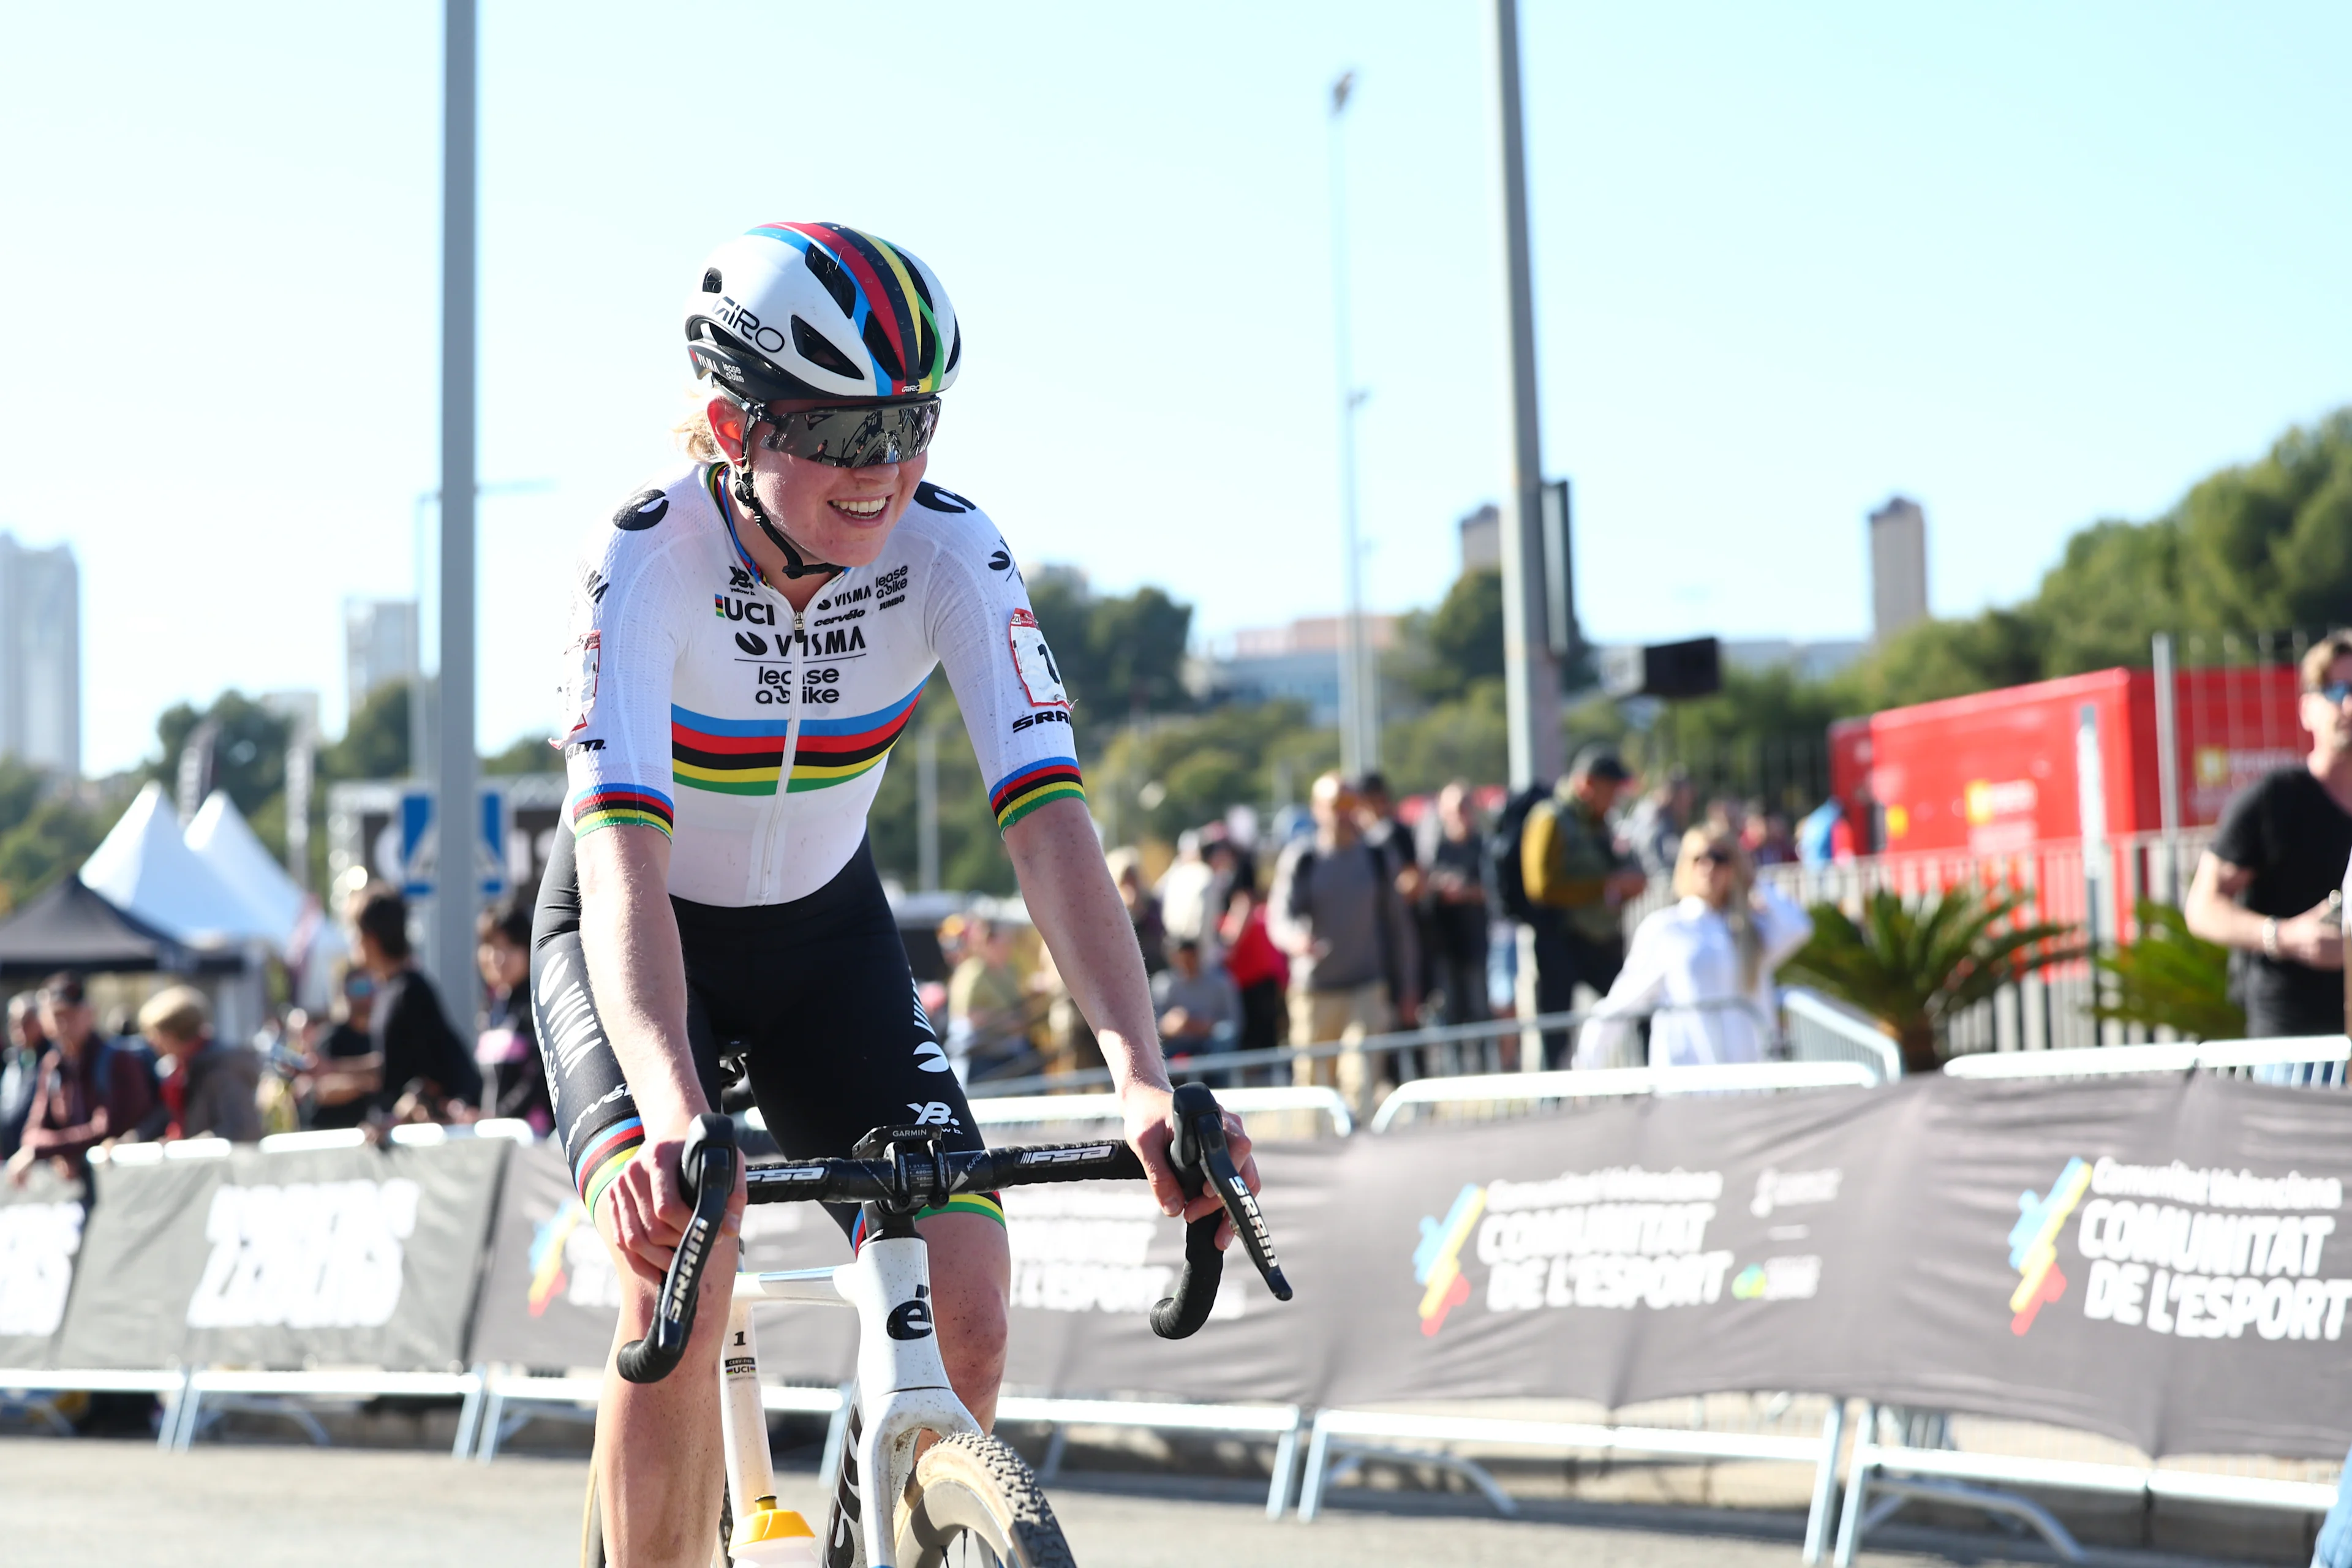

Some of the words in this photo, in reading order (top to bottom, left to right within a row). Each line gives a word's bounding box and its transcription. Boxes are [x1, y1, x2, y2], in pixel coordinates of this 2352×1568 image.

[712, 296, 785, 353] GIRO
[696, 352, 720, 374] VISMA
[876, 565, 908, 588] lease
[835, 585, 872, 606] VISMA
[879, 595, 905, 611] JUMBO
[724, 596, 775, 626] UCI
[814, 609, 865, 627] cervélo
[775, 626, 866, 657] VISMA
[758, 666, 840, 685] lease
[1012, 710, 1072, 733] SRA
[546, 981, 603, 1079] VISMA
[892, 1129, 927, 1137] GARMIN
[1229, 1175, 1279, 1268] SRAM
[1478, 1203, 1716, 1264] COMUNITAT
[2078, 1199, 2335, 1276] COMUNITAT
[667, 1216, 709, 1323] SRAM
[1487, 1258, 1546, 1311] DE
[2084, 1261, 2149, 1325] DE
[2146, 1270, 2352, 1340] L'ESPORT
[733, 1330, 747, 1346] 1
[733, 1365, 750, 1374] UCI
